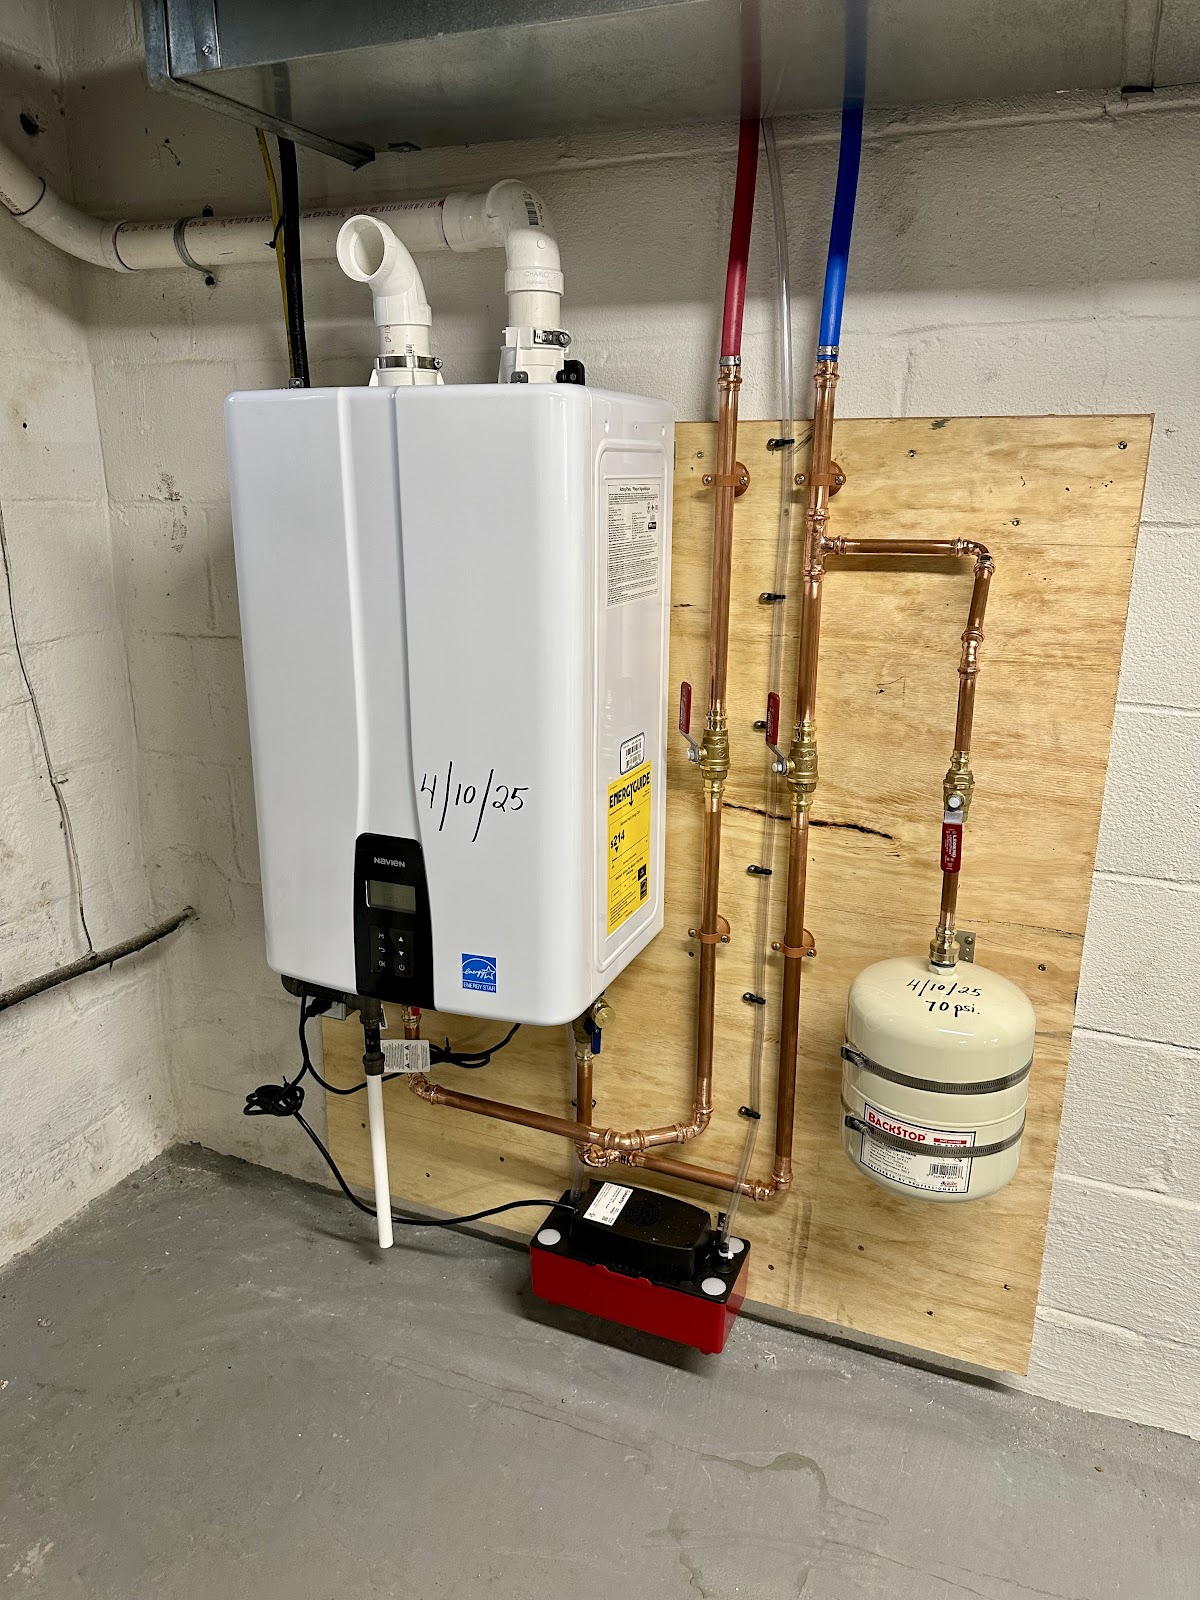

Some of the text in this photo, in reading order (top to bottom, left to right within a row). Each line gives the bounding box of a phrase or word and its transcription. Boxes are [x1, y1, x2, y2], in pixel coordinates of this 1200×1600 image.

[420, 760, 530, 843] 4/10/25
[463, 981, 496, 992] ENERGY STAR
[906, 978, 983, 997] 4/10/25
[925, 1000, 950, 1012] 70
[868, 1111, 926, 1142] BACKSTOP
